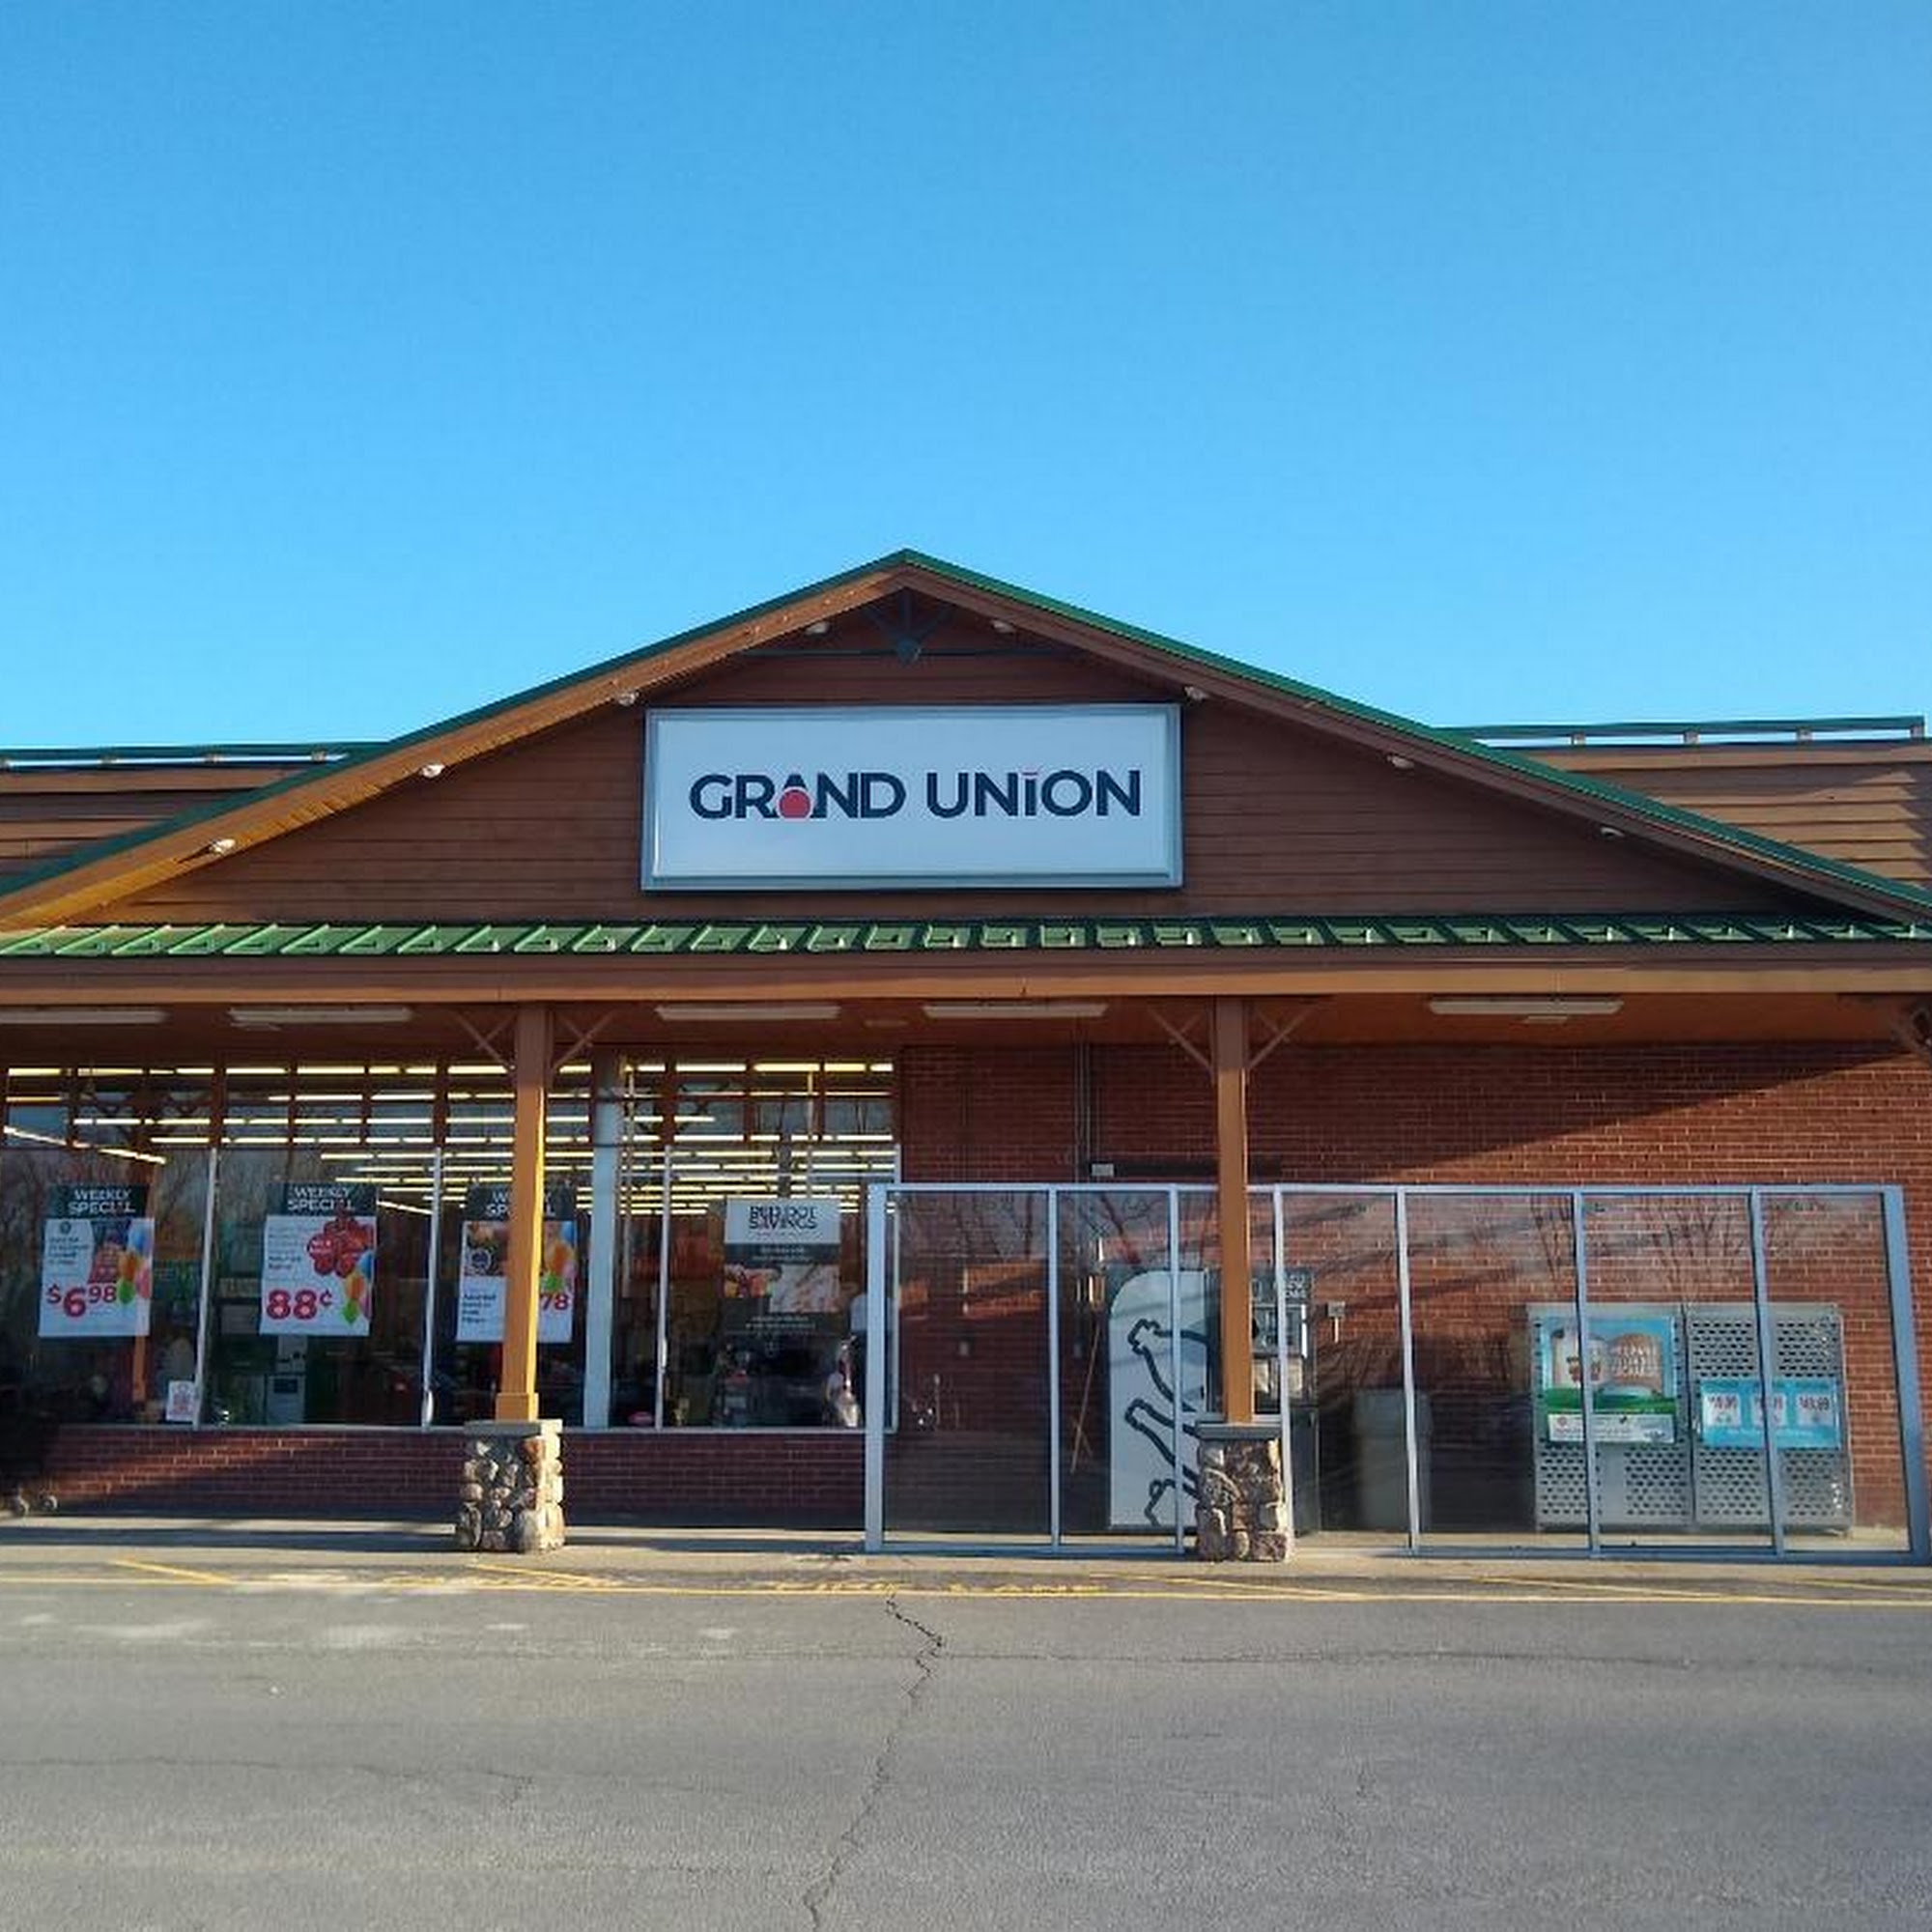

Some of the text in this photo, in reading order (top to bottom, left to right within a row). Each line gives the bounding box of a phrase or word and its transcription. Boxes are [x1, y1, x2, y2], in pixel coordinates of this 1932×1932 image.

[689, 769, 1141, 819] GRAND UNION
[73, 1188, 131, 1200] WEEKLY
